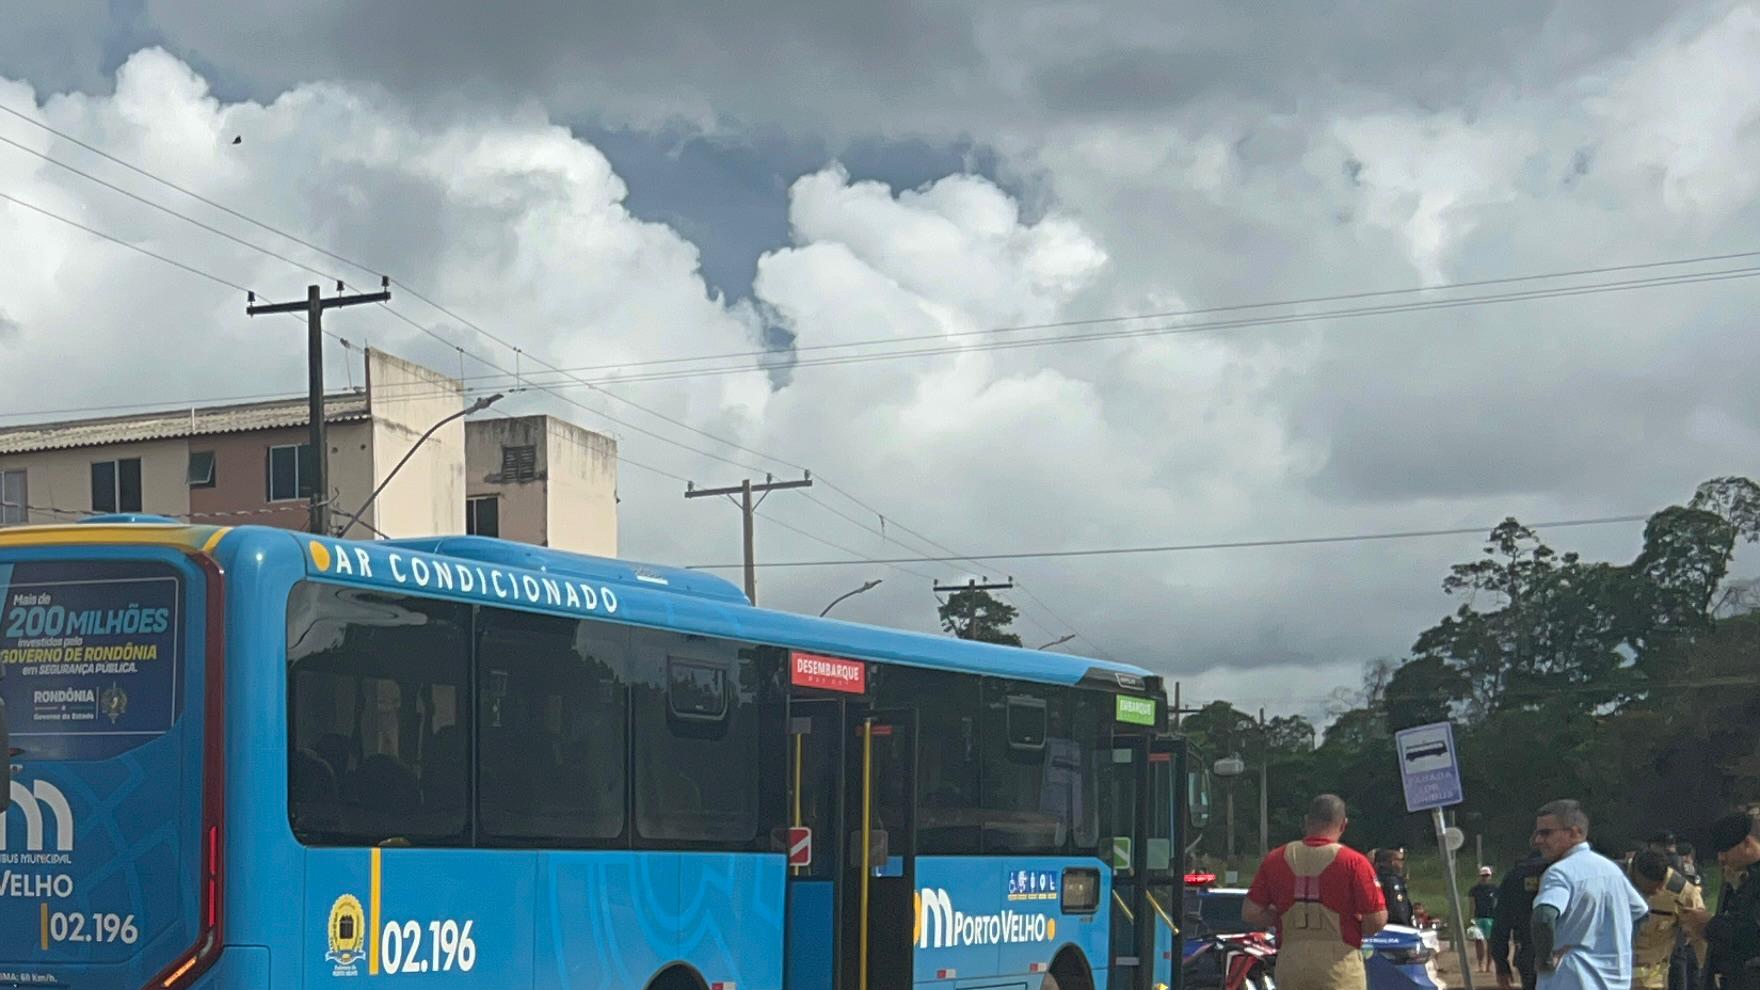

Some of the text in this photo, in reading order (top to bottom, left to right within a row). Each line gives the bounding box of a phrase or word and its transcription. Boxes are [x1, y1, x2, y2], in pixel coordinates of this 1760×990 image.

[335, 545, 618, 613] AR CONDICIONADO
[13, 592, 51, 606] Mais de
[6, 603, 170, 638] 200 MILHÕES
[1, 642, 157, 664] GOVERNO DE RONDÔNIA
[22, 667, 38, 676] em
[38, 663, 95, 676] SEGURANÇA
[797, 658, 860, 681] DESEMBARQUE
[33, 687, 95, 703] RONDÔNIA
[20, 853, 73, 865] MUNICIPAL
[49, 911, 139, 945] 02.196
[381, 919, 476, 975] 02.196
